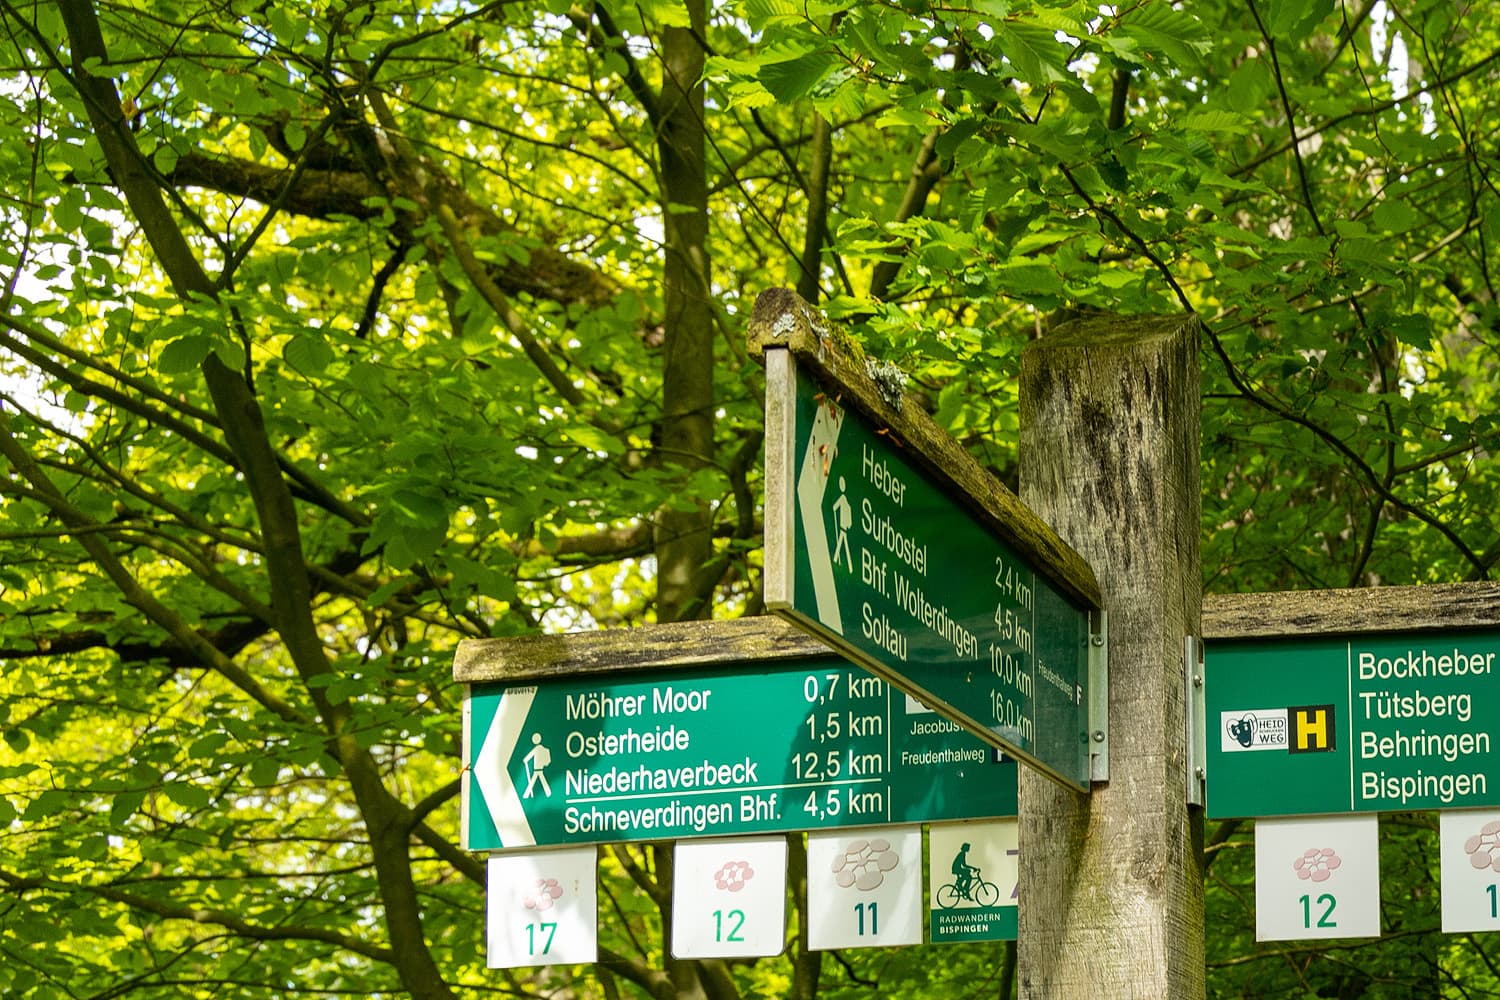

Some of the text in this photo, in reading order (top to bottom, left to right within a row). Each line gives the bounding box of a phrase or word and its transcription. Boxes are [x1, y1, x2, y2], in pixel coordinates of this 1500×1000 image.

[862, 443, 1031, 611] Heber 2,4 km
[861, 503, 1031, 655] Surbostel 4,5 km
[861, 552, 1032, 698] Bhf. Wolterdingen 10,0 km
[861, 603, 1033, 741] Soltau 16,0 km
[1357, 649, 1495, 681] Bockheber
[565, 672, 882, 721] Möhrer Moor 0,7 km
[1358, 690, 1472, 722] Tütsberg
[565, 711, 882, 757] Osterheide 1,5 km
[910, 720, 965, 735] Jacobus
[1259, 720, 1284, 729] HEID
[1259, 734, 1284, 743] WEG
[1296, 709, 1327, 749] H
[901, 748, 985, 766] Freudenthalweg
[1361, 730, 1490, 762] Behringen
[565, 749, 882, 795] Niederhaverbeck 12,5 km
[1361, 771, 1487, 804] Bispingen
[565, 788, 882, 833] Schneverdingen Bhf. 4,5 km
[713, 909, 746, 943] 12
[854, 902, 879, 936] 11
[939, 913, 1001, 924] RADWANDERN
[1299, 893, 1338, 929] 12
[525, 922, 558, 956] 17
[939, 924, 989, 934] BISPINGEN
